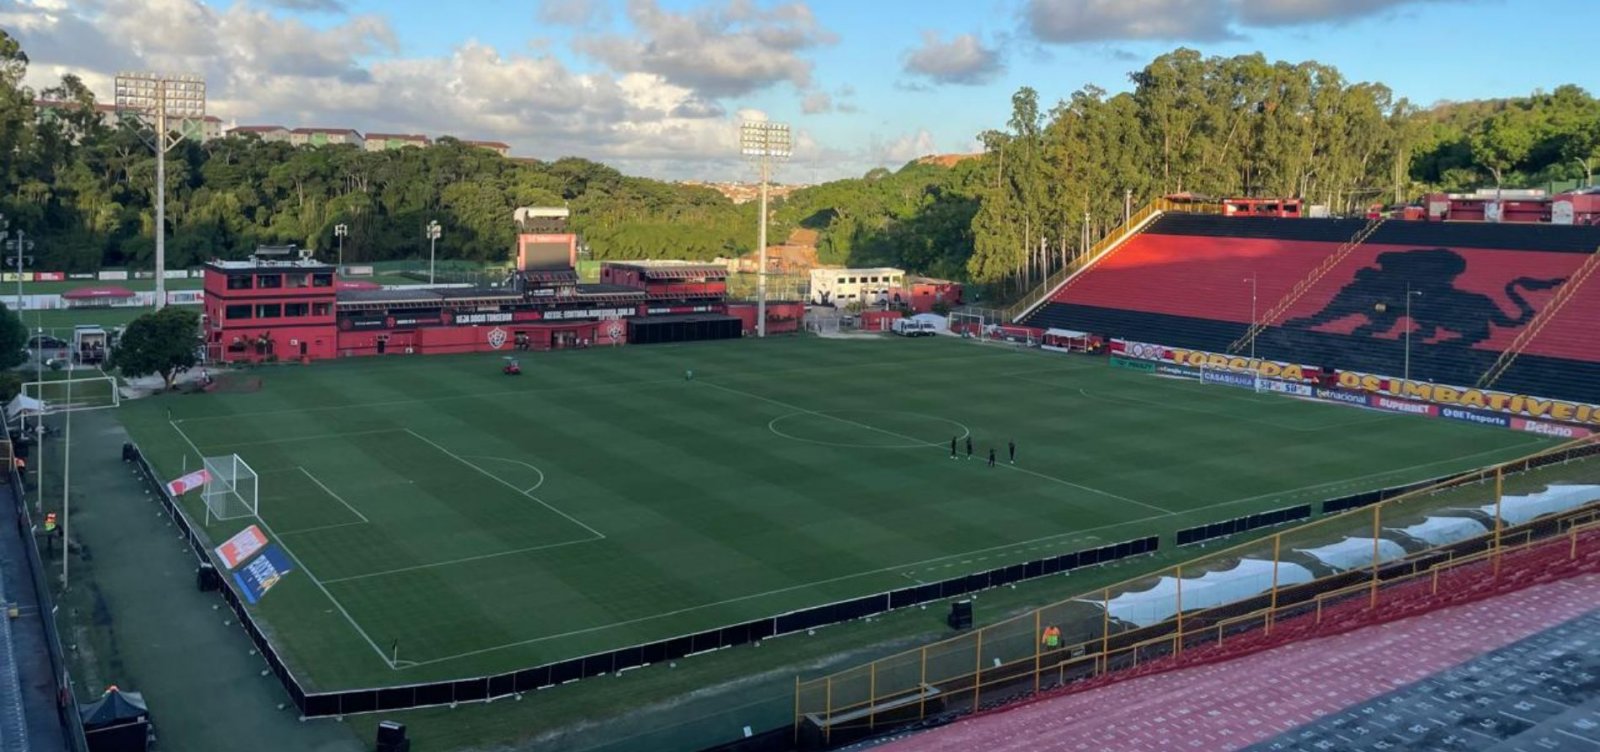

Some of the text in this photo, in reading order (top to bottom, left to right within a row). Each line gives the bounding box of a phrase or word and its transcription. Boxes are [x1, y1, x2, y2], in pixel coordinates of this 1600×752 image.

[1172, 349, 1303, 382] TORCIDA
[1339, 371, 1380, 393] OS
[1316, 388, 1366, 404] betnacional
[1379, 397, 1429, 414] SUPERBET
[1524, 420, 1572, 438] Betano
